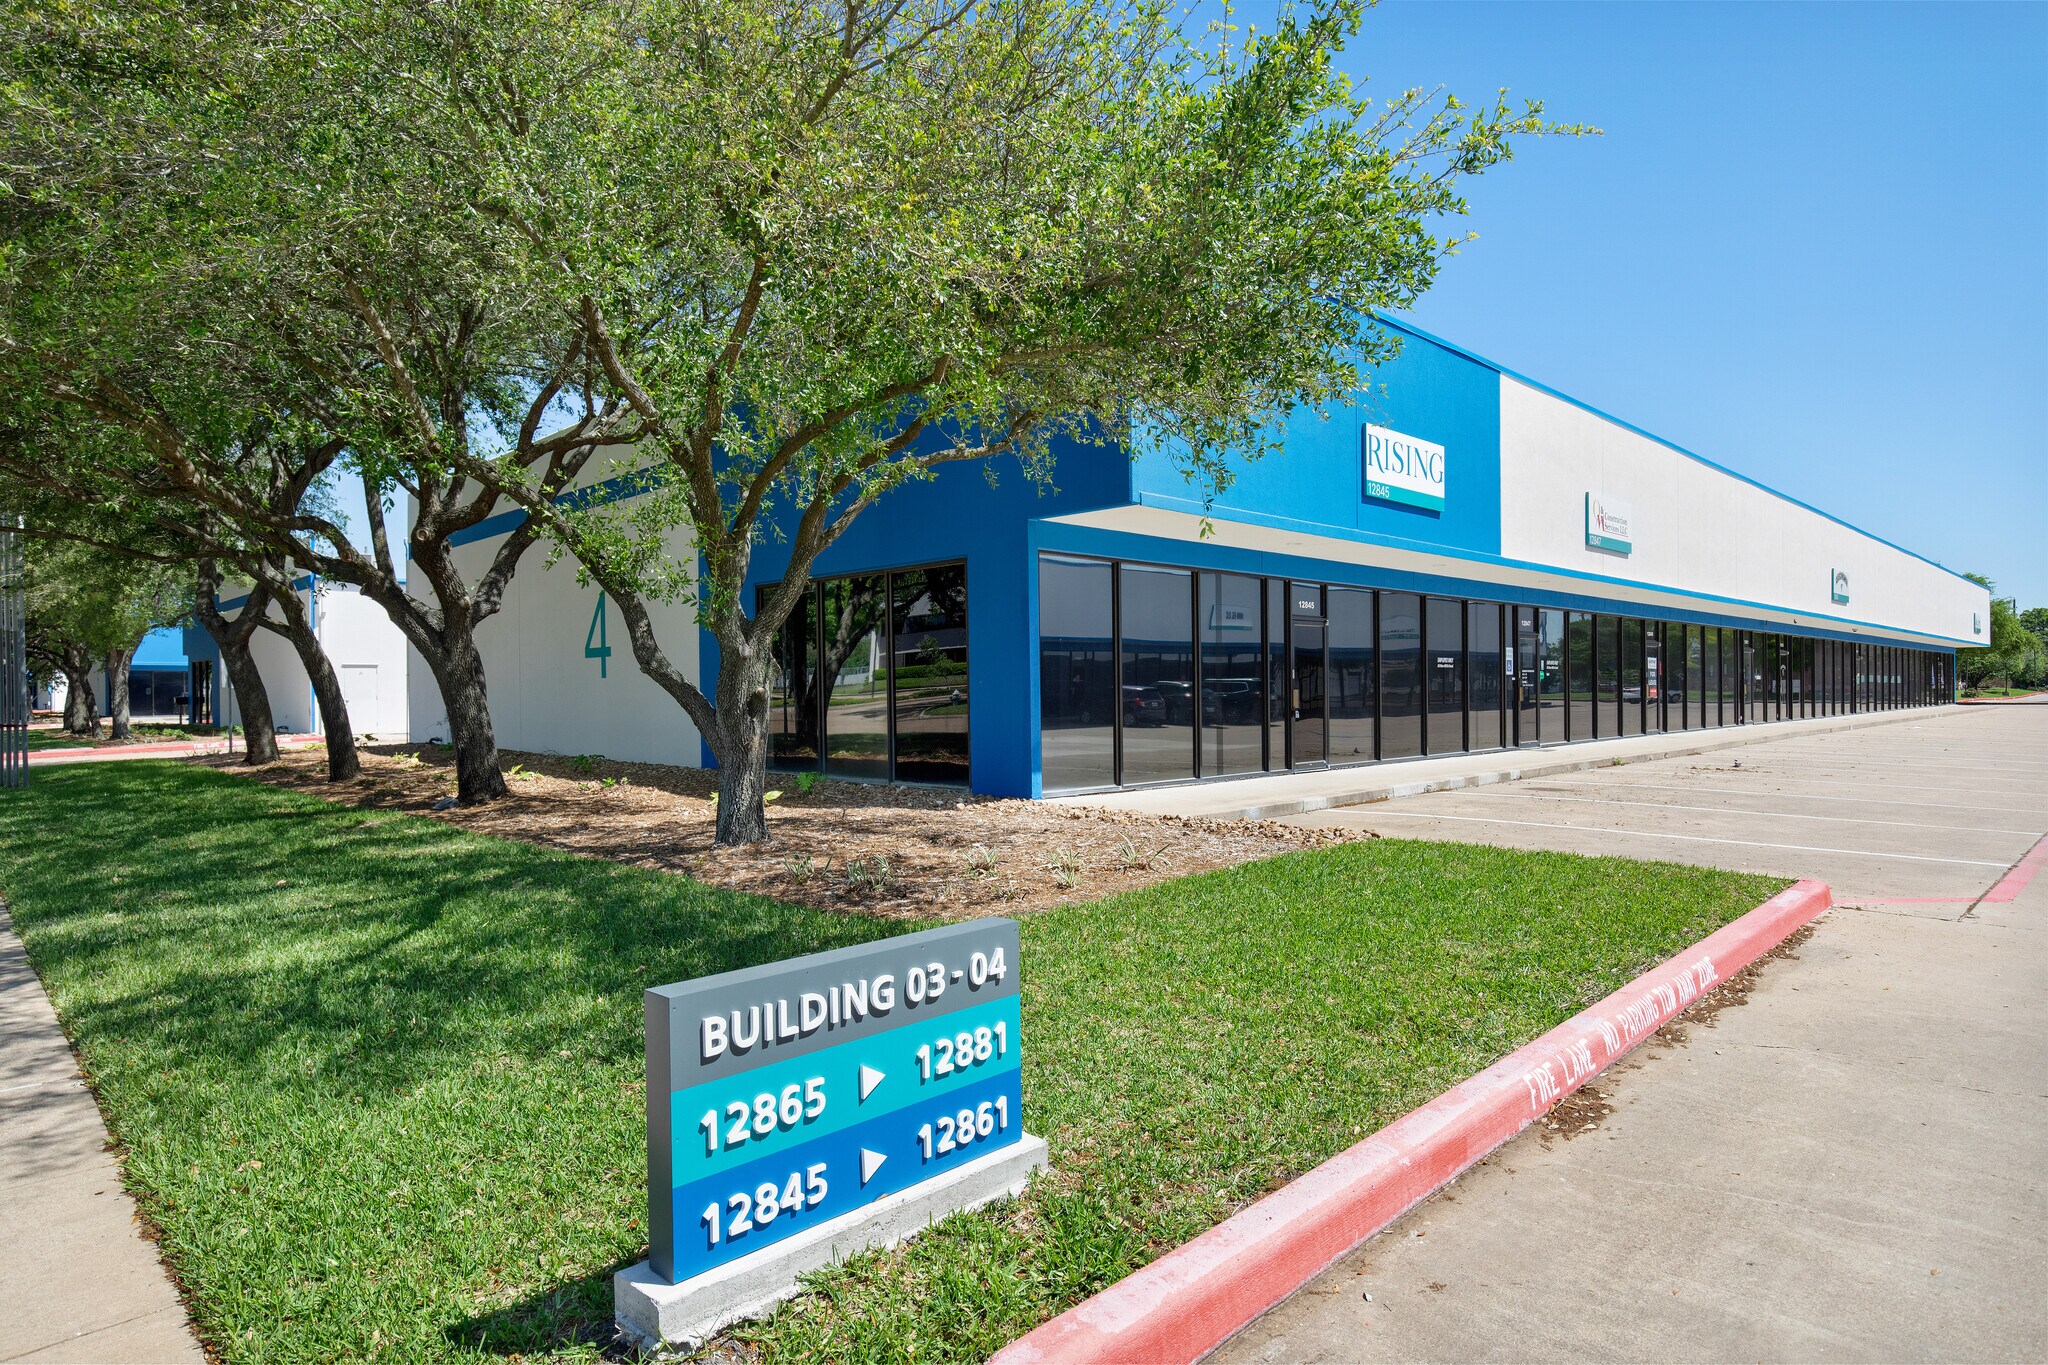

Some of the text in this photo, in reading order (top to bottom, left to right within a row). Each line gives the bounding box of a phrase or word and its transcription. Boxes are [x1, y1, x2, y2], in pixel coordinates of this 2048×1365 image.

[1368, 434, 1443, 483] RISING
[1368, 483, 1390, 498] 12845
[1605, 512, 1628, 526] Construction
[1605, 521, 1628, 535] Services LLC
[585, 590, 612, 678] 4
[1298, 600, 1315, 610] 12845
[701, 974, 895, 1059] BUILDING
[1522, 956, 1718, 1110] FIRE LANE NO PARKING TOW AWAY ZONE
[700, 1021, 1008, 1152] 12865 12881
[701, 1096, 1009, 1244] 12845 12861
